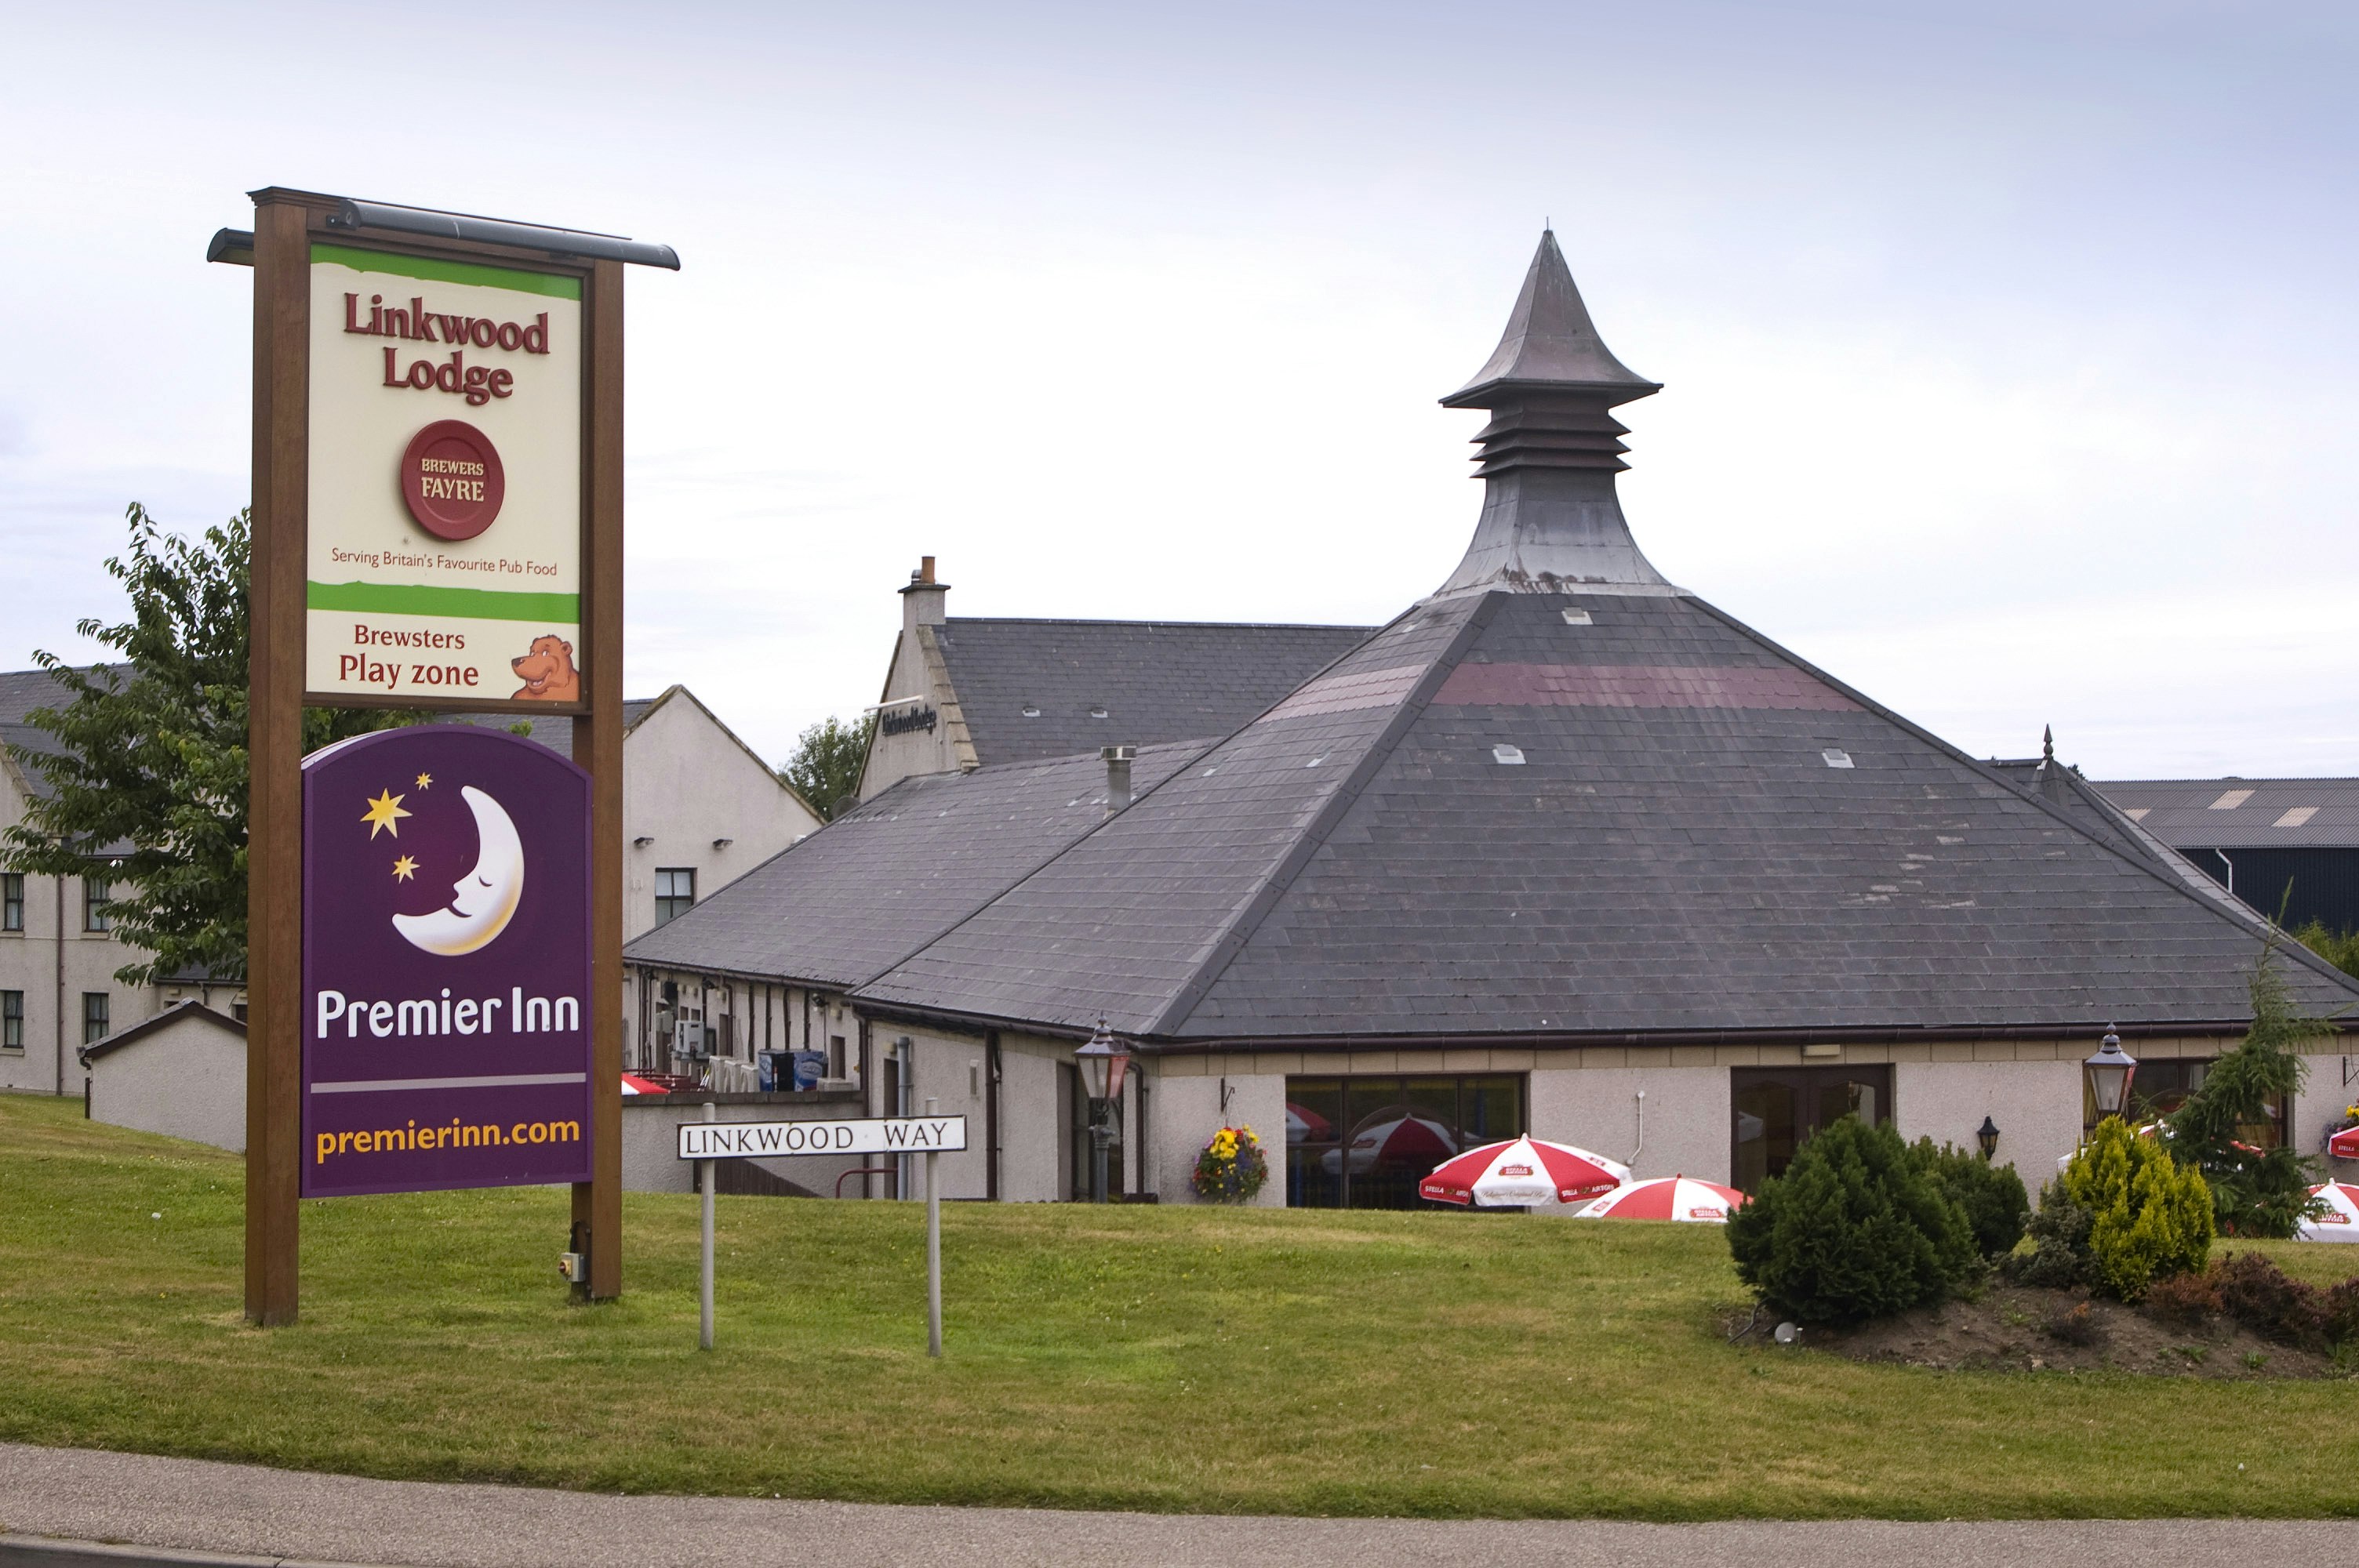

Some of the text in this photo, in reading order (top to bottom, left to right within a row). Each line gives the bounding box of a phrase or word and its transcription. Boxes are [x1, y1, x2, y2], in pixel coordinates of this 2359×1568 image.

[343, 292, 551, 354] Linkwood
[383, 347, 514, 406] Lodge
[421, 458, 484, 476] BREWERS
[421, 477, 485, 502] FAYRE
[332, 547, 557, 576] Serving Britain's Favourite Pub Food
[354, 624, 465, 650] Brewsters
[339, 652, 479, 690] Play zone
[318, 986, 579, 1039] Premier Inn
[317, 1117, 580, 1164] premierinn.com
[686, 1122, 947, 1154] LINKWOOD WAY
